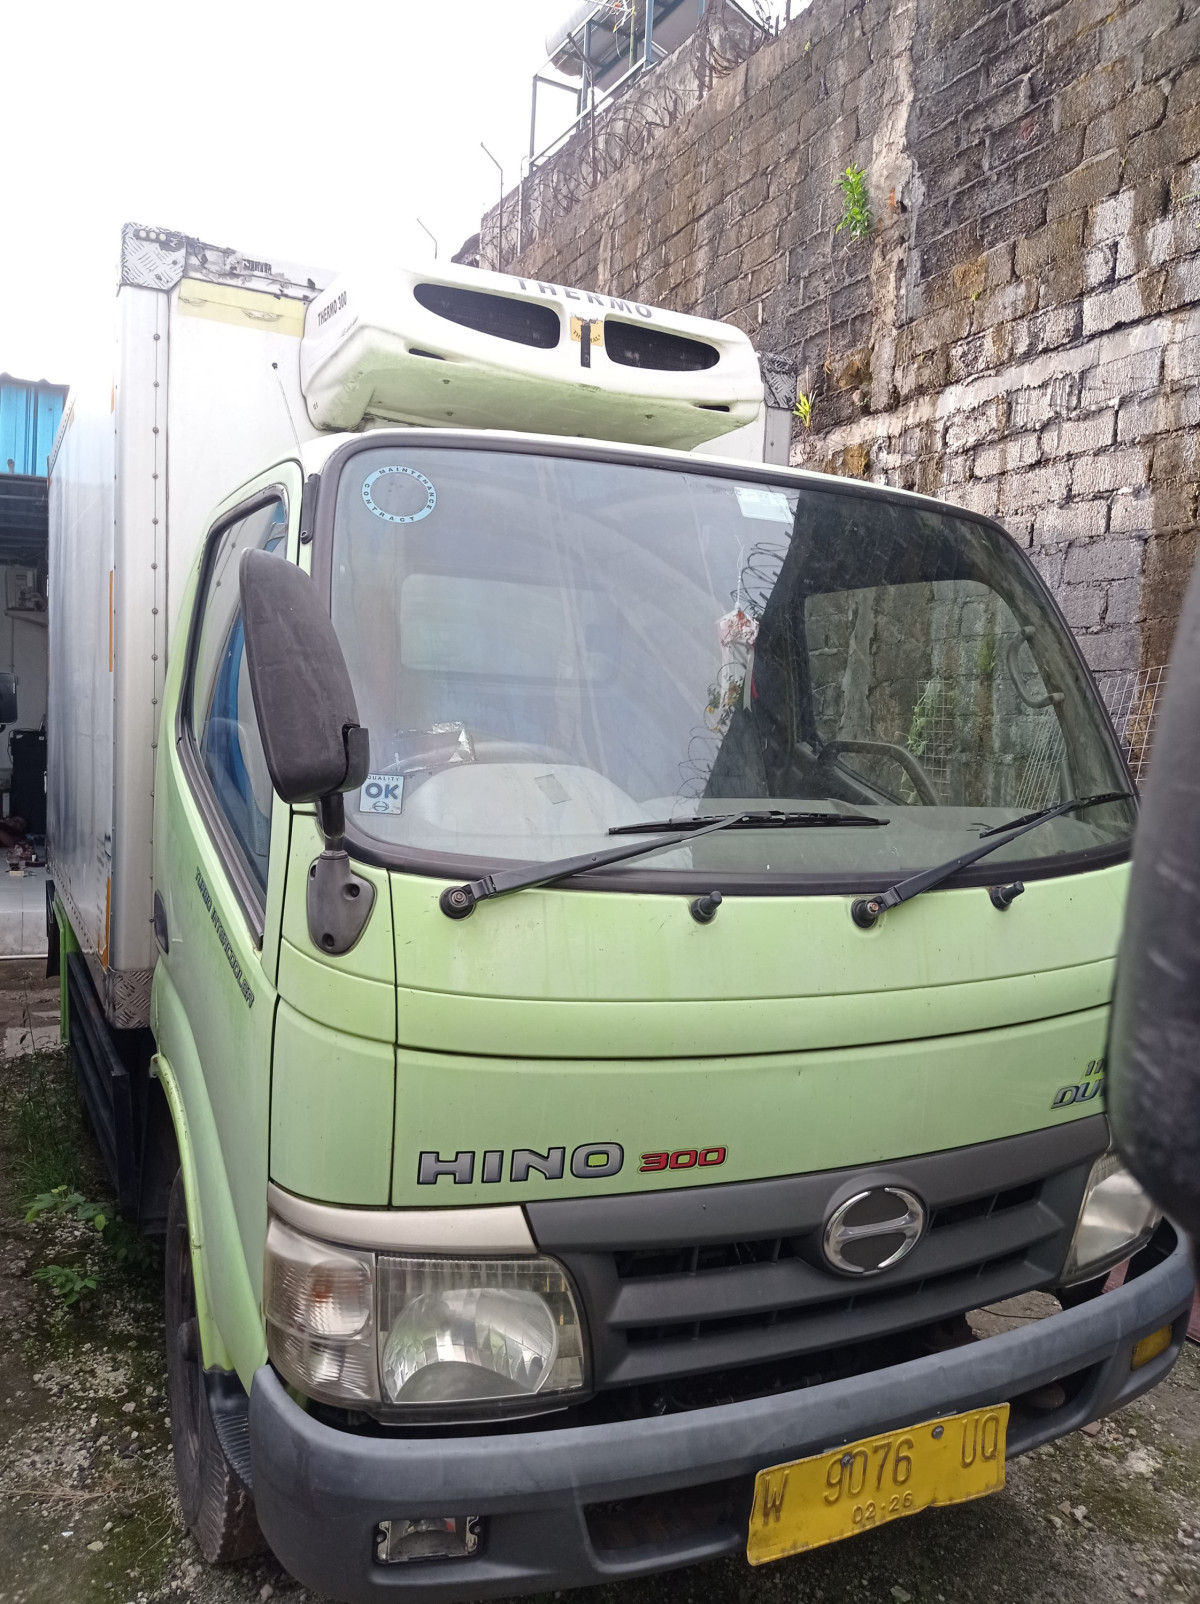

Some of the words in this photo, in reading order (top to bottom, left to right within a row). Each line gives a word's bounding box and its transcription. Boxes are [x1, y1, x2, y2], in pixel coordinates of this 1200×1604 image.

[318, 299, 337, 327] THERMO
[338, 291, 347, 310] 300
[512, 277, 652, 319] THERMO
[364, 483, 414, 522] CONTRACT
[379, 467, 434, 509] MAINTENANCE
[365, 783, 399, 799] OK
[417, 1142, 624, 1185] HINO
[639, 1147, 726, 1172] 300
[763, 1470, 790, 1526] W
[824, 1436, 913, 1505] 9076
